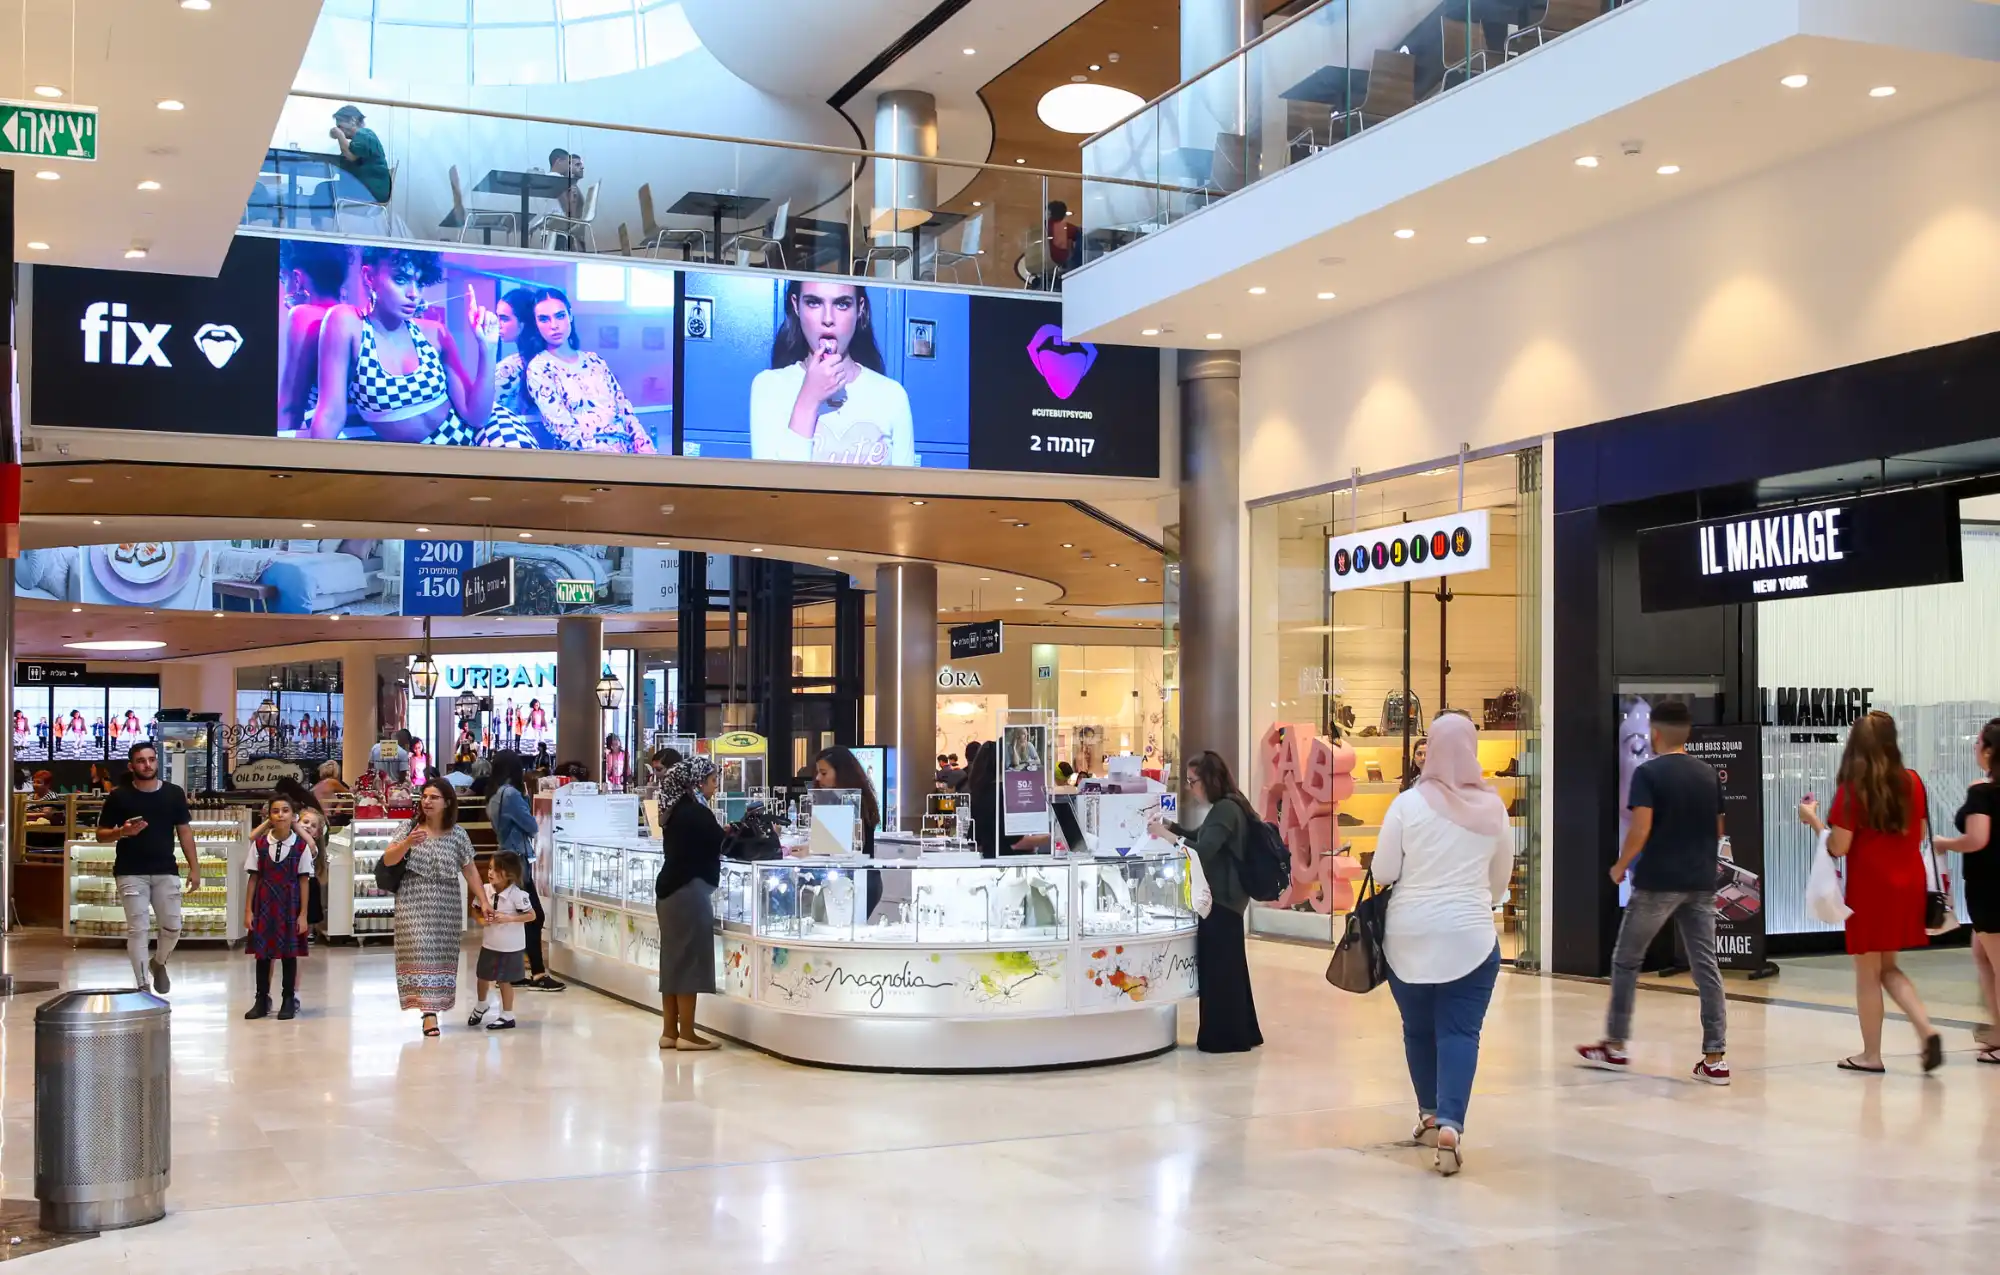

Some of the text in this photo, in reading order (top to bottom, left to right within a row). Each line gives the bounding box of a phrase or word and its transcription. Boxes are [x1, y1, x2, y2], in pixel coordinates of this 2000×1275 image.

[21, 111, 93, 157] יציאה
[80, 302, 173, 368] fix
[1032, 408, 1093, 420] #CUTEBUTPSYCHO
[1030, 435, 1096, 457] קומה 2
[1700, 507, 1844, 575] IL MAKIAGE
[418, 566, 458, 576] משלמים רק
[561, 583, 592, 602] יציאה
[1753, 575, 1809, 594] NEW YORK
[1684, 741, 1743, 752] COLOR BOSS SQUAD
